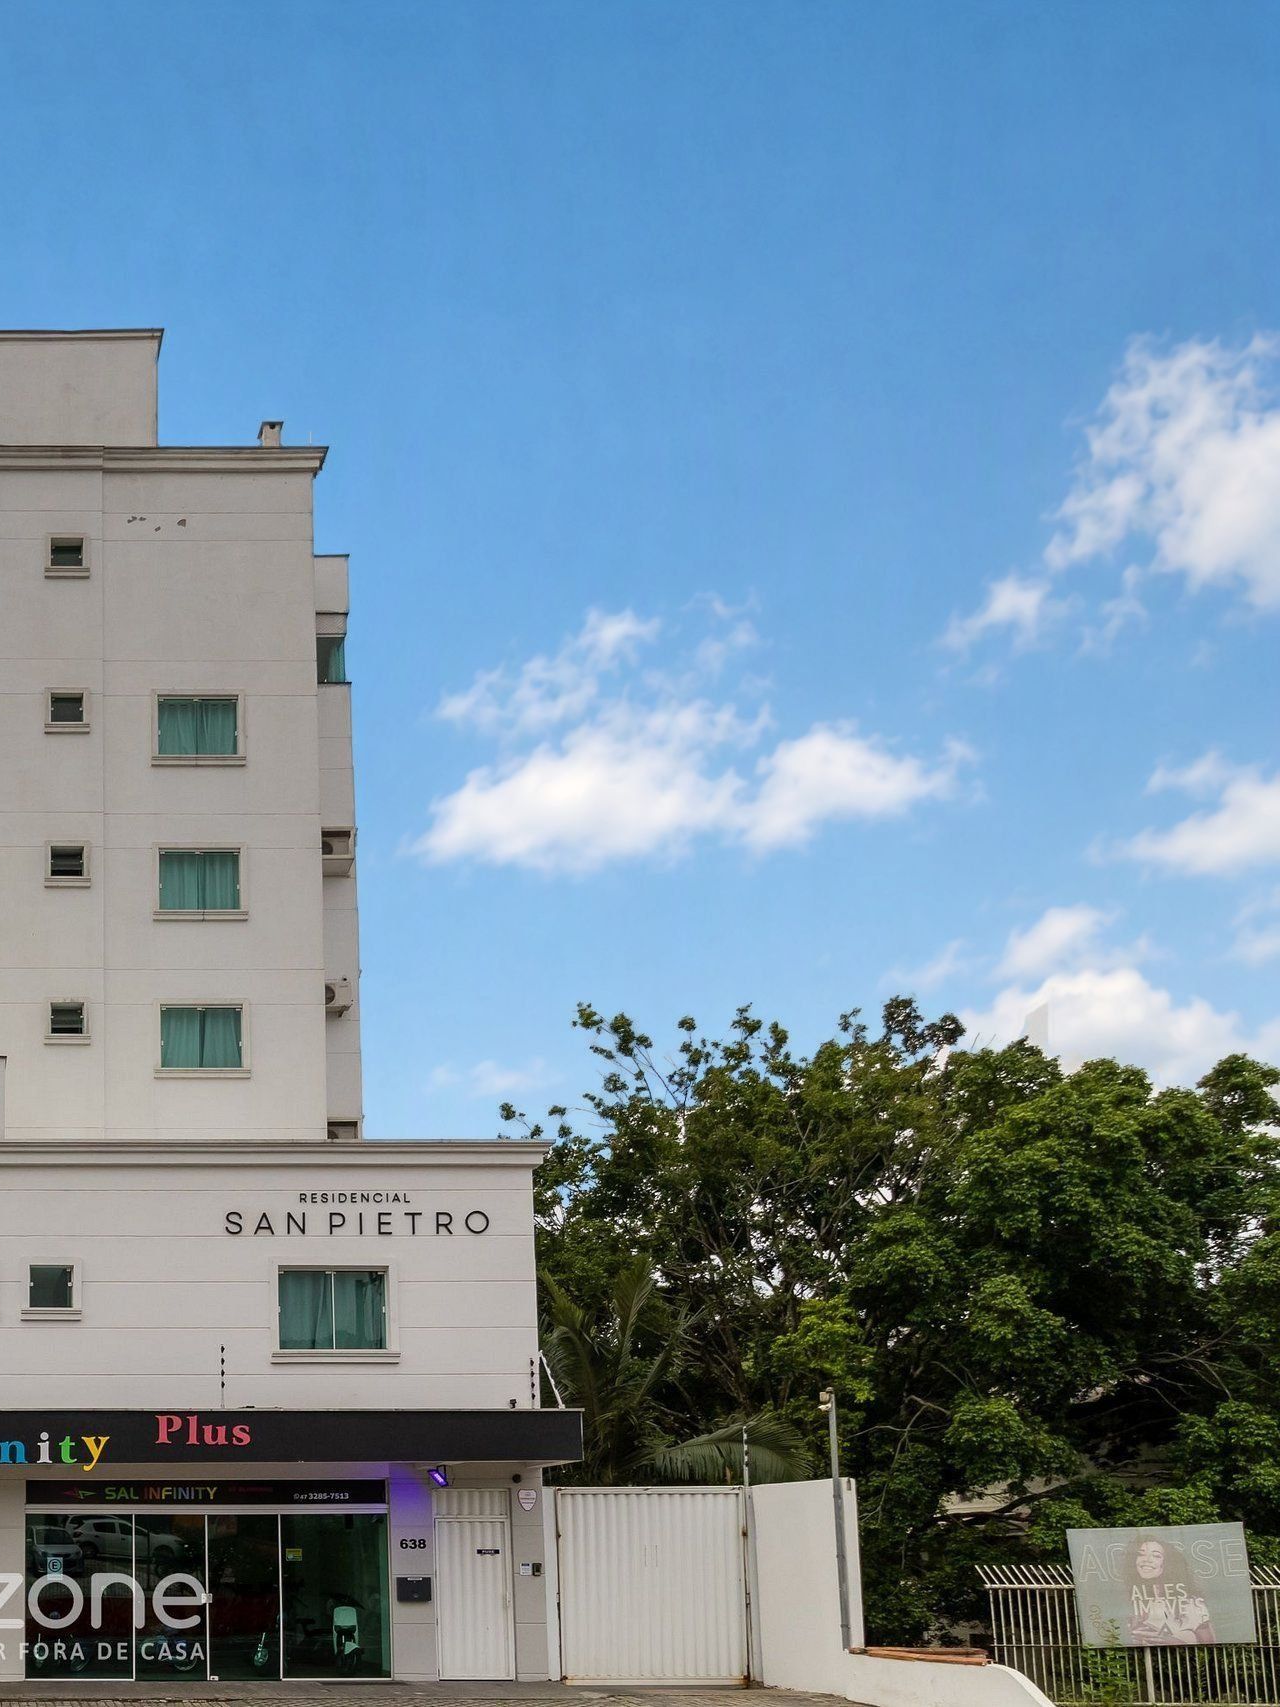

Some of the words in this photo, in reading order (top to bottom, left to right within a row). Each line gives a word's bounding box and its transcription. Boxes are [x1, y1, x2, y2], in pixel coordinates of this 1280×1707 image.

[299, 1192, 411, 1204] RESIDENCIAL
[225, 1211, 306, 1236] SAN
[329, 1210, 490, 1236] PIETRO
[154, 1414, 252, 1447] Plus
[104, 1486, 138, 1500] SAL
[143, 1486, 218, 1500] INFINITY
[399, 1538, 427, 1549] 638
[1131, 1583, 1188, 1601] ALLES
